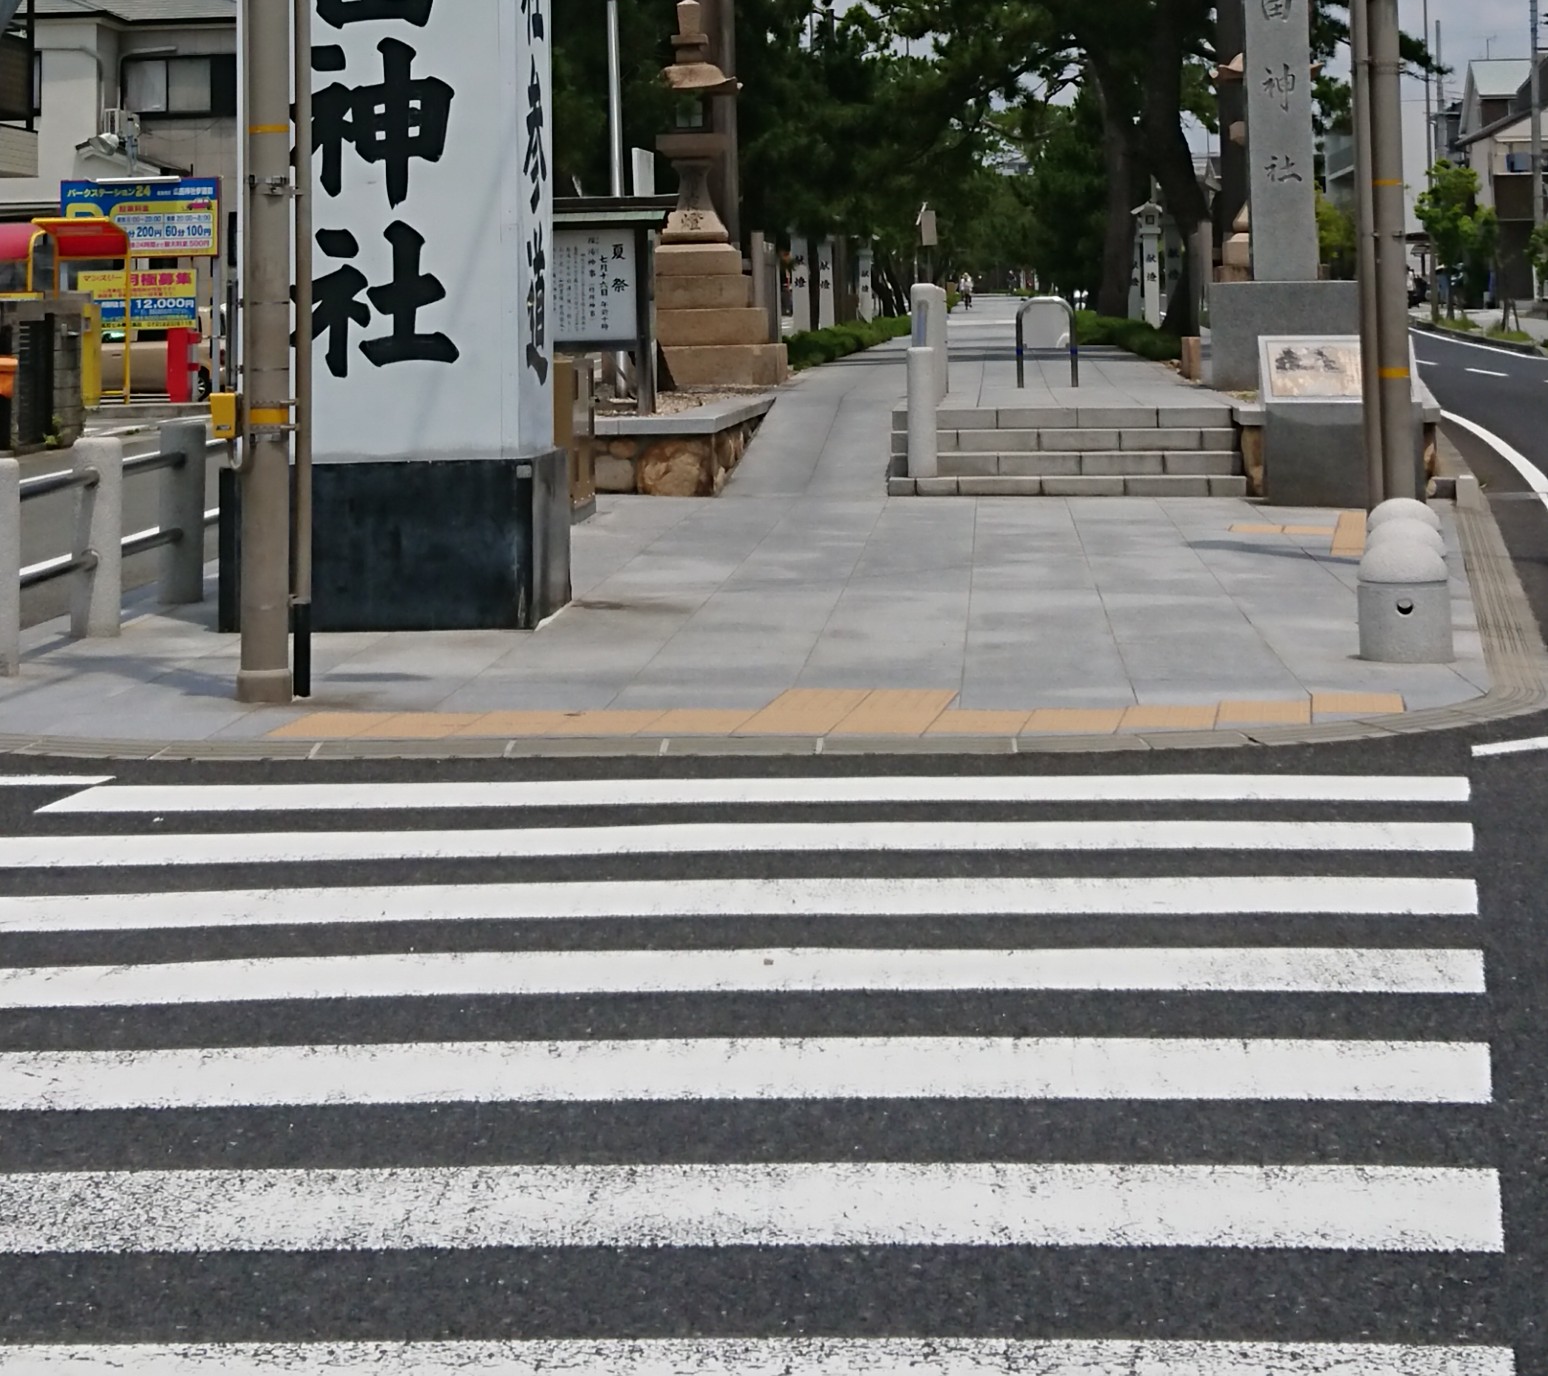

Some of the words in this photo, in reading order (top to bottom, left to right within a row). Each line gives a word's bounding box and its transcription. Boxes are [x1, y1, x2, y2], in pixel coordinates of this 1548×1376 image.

[136, 225, 162, 238] 200円
[165, 225, 185, 237] 60分
[187, 224, 212, 237] 100円
[611, 243, 629, 293] 夏祭
[136, 298, 195, 309] 12,000円
